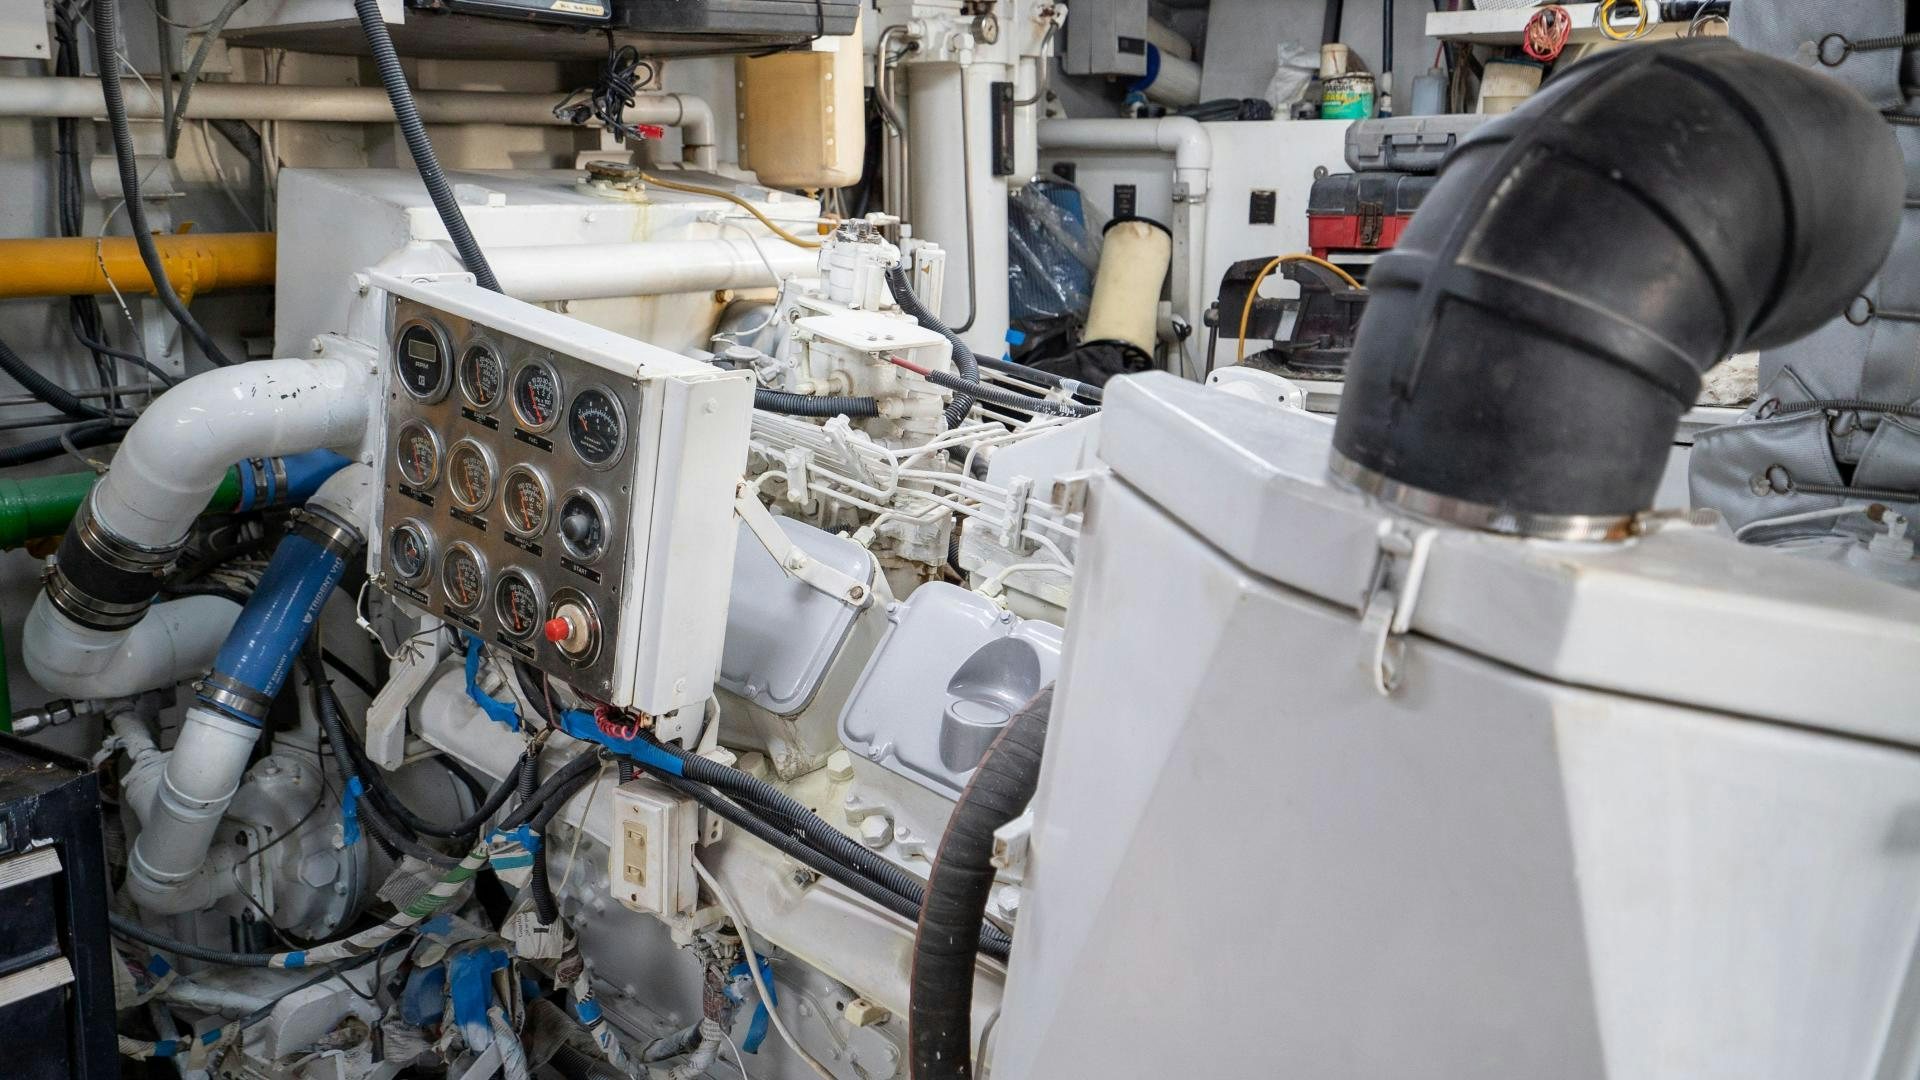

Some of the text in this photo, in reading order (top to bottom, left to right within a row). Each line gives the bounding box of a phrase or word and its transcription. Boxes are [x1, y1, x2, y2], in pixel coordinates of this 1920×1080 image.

[415, 361, 429, 369] RPM
[573, 564, 587, 575] START
[310, 575, 334, 612] TRIDENT
